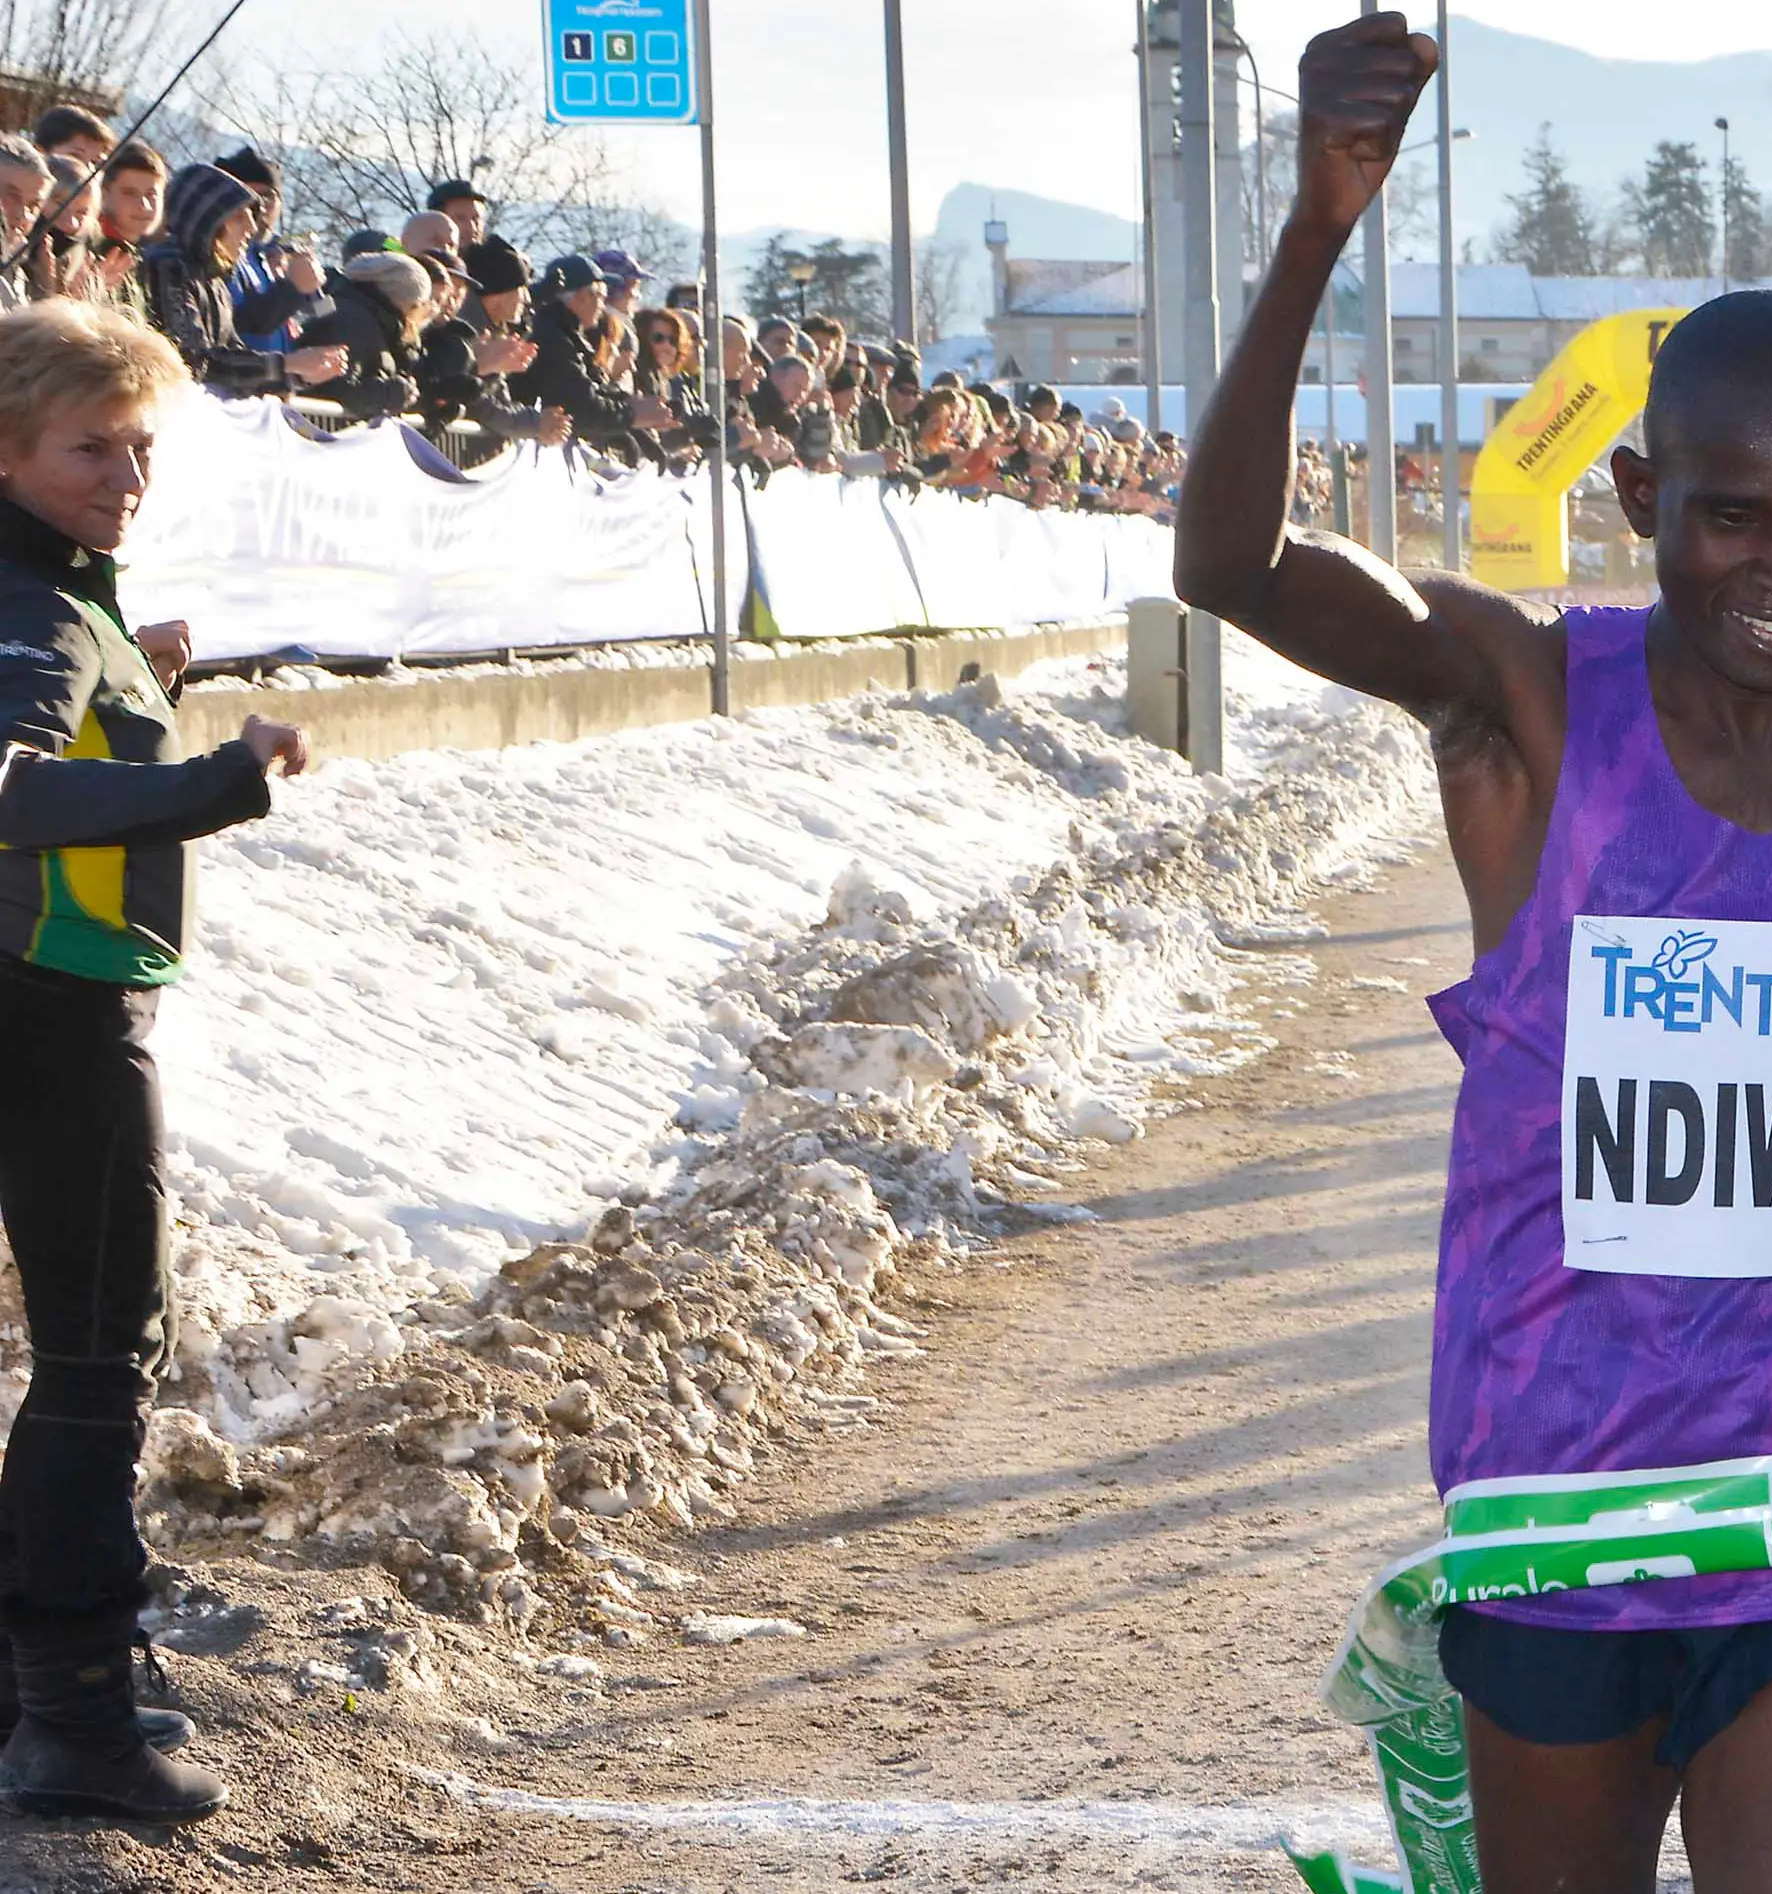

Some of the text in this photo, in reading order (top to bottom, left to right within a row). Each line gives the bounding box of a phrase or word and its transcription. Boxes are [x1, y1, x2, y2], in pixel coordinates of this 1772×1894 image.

[572, 37, 627, 56] 1 6
[1515, 382, 1598, 472] TRENTINGRANA
